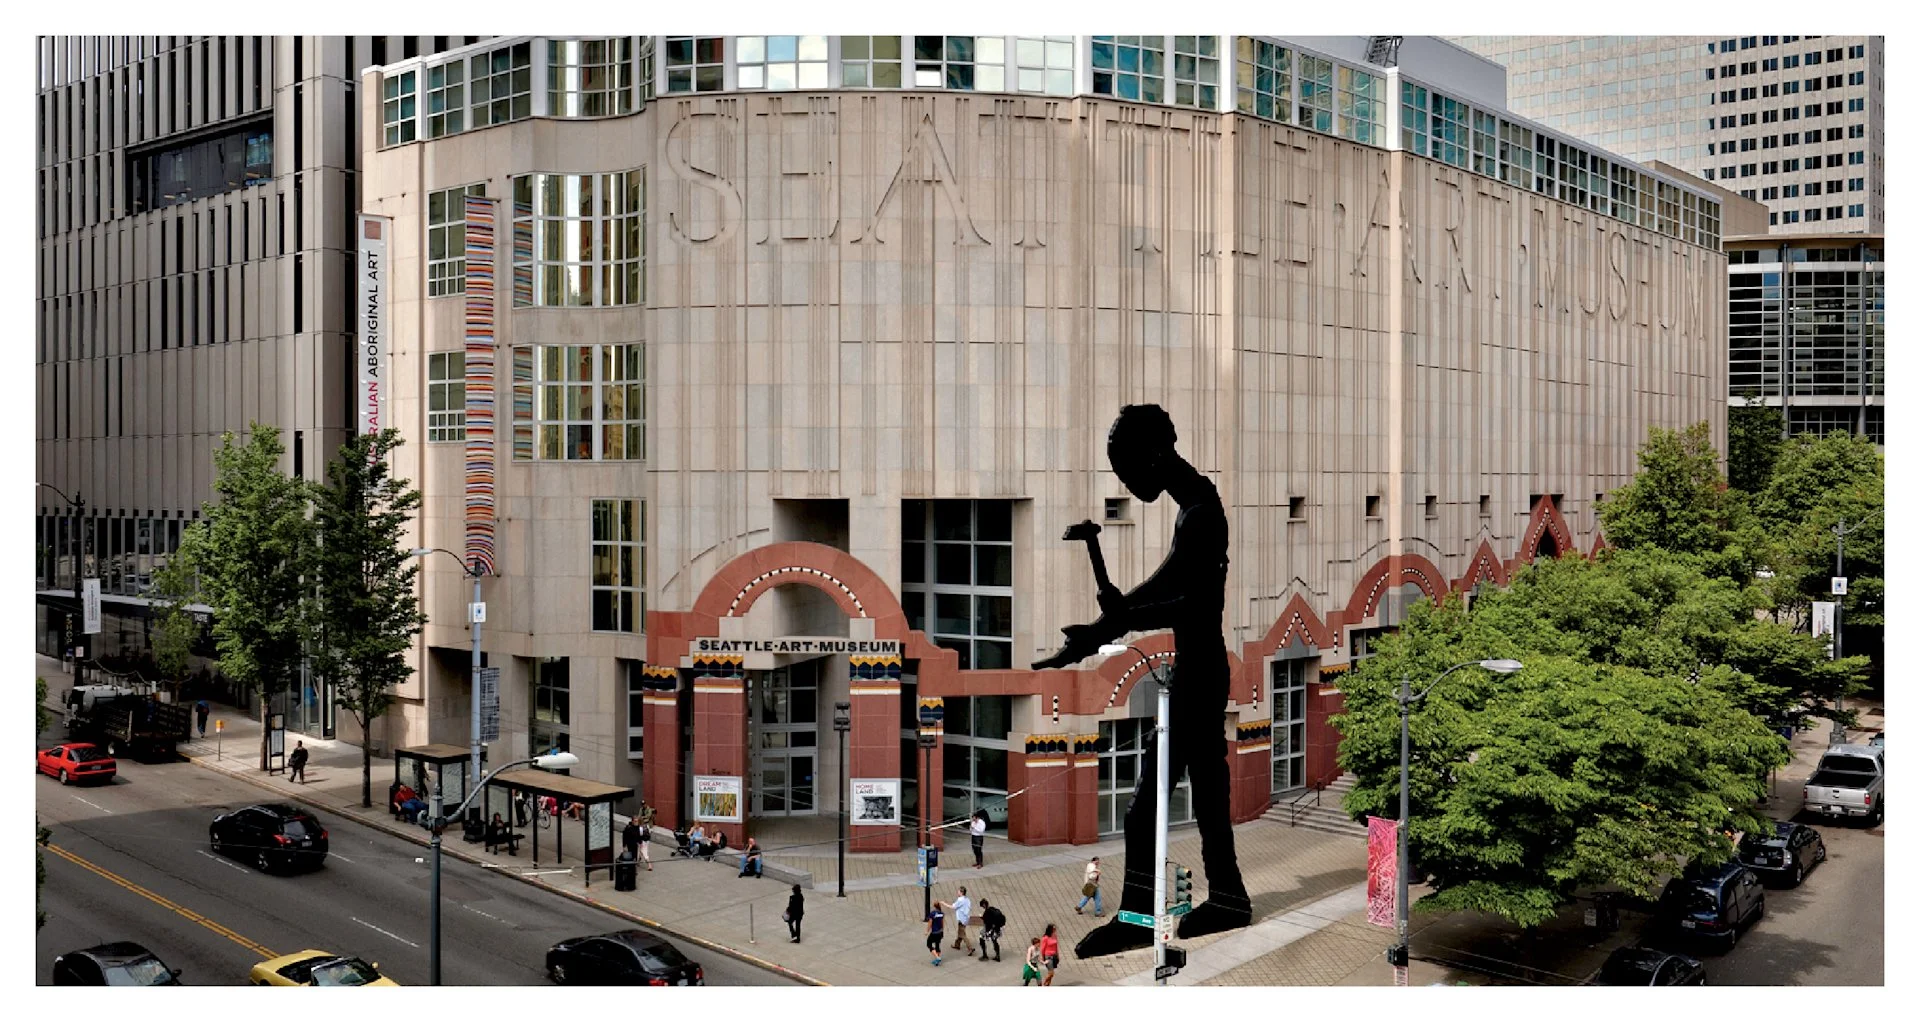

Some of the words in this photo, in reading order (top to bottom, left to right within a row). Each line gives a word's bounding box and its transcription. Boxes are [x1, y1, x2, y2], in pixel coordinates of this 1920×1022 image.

[367, 250, 378, 281] ART
[665, 111, 1317, 268] SEATTLE
[1349, 168, 1510, 299] ART
[1533, 208, 1707, 341] MUSEUM
[367, 284, 378, 377] ABORIGINAL
[367, 381, 378, 465] USRALIAN
[699, 639, 773, 652] SEATTLE
[779, 640, 814, 652] ART
[819, 641, 897, 653] MUSEUM
